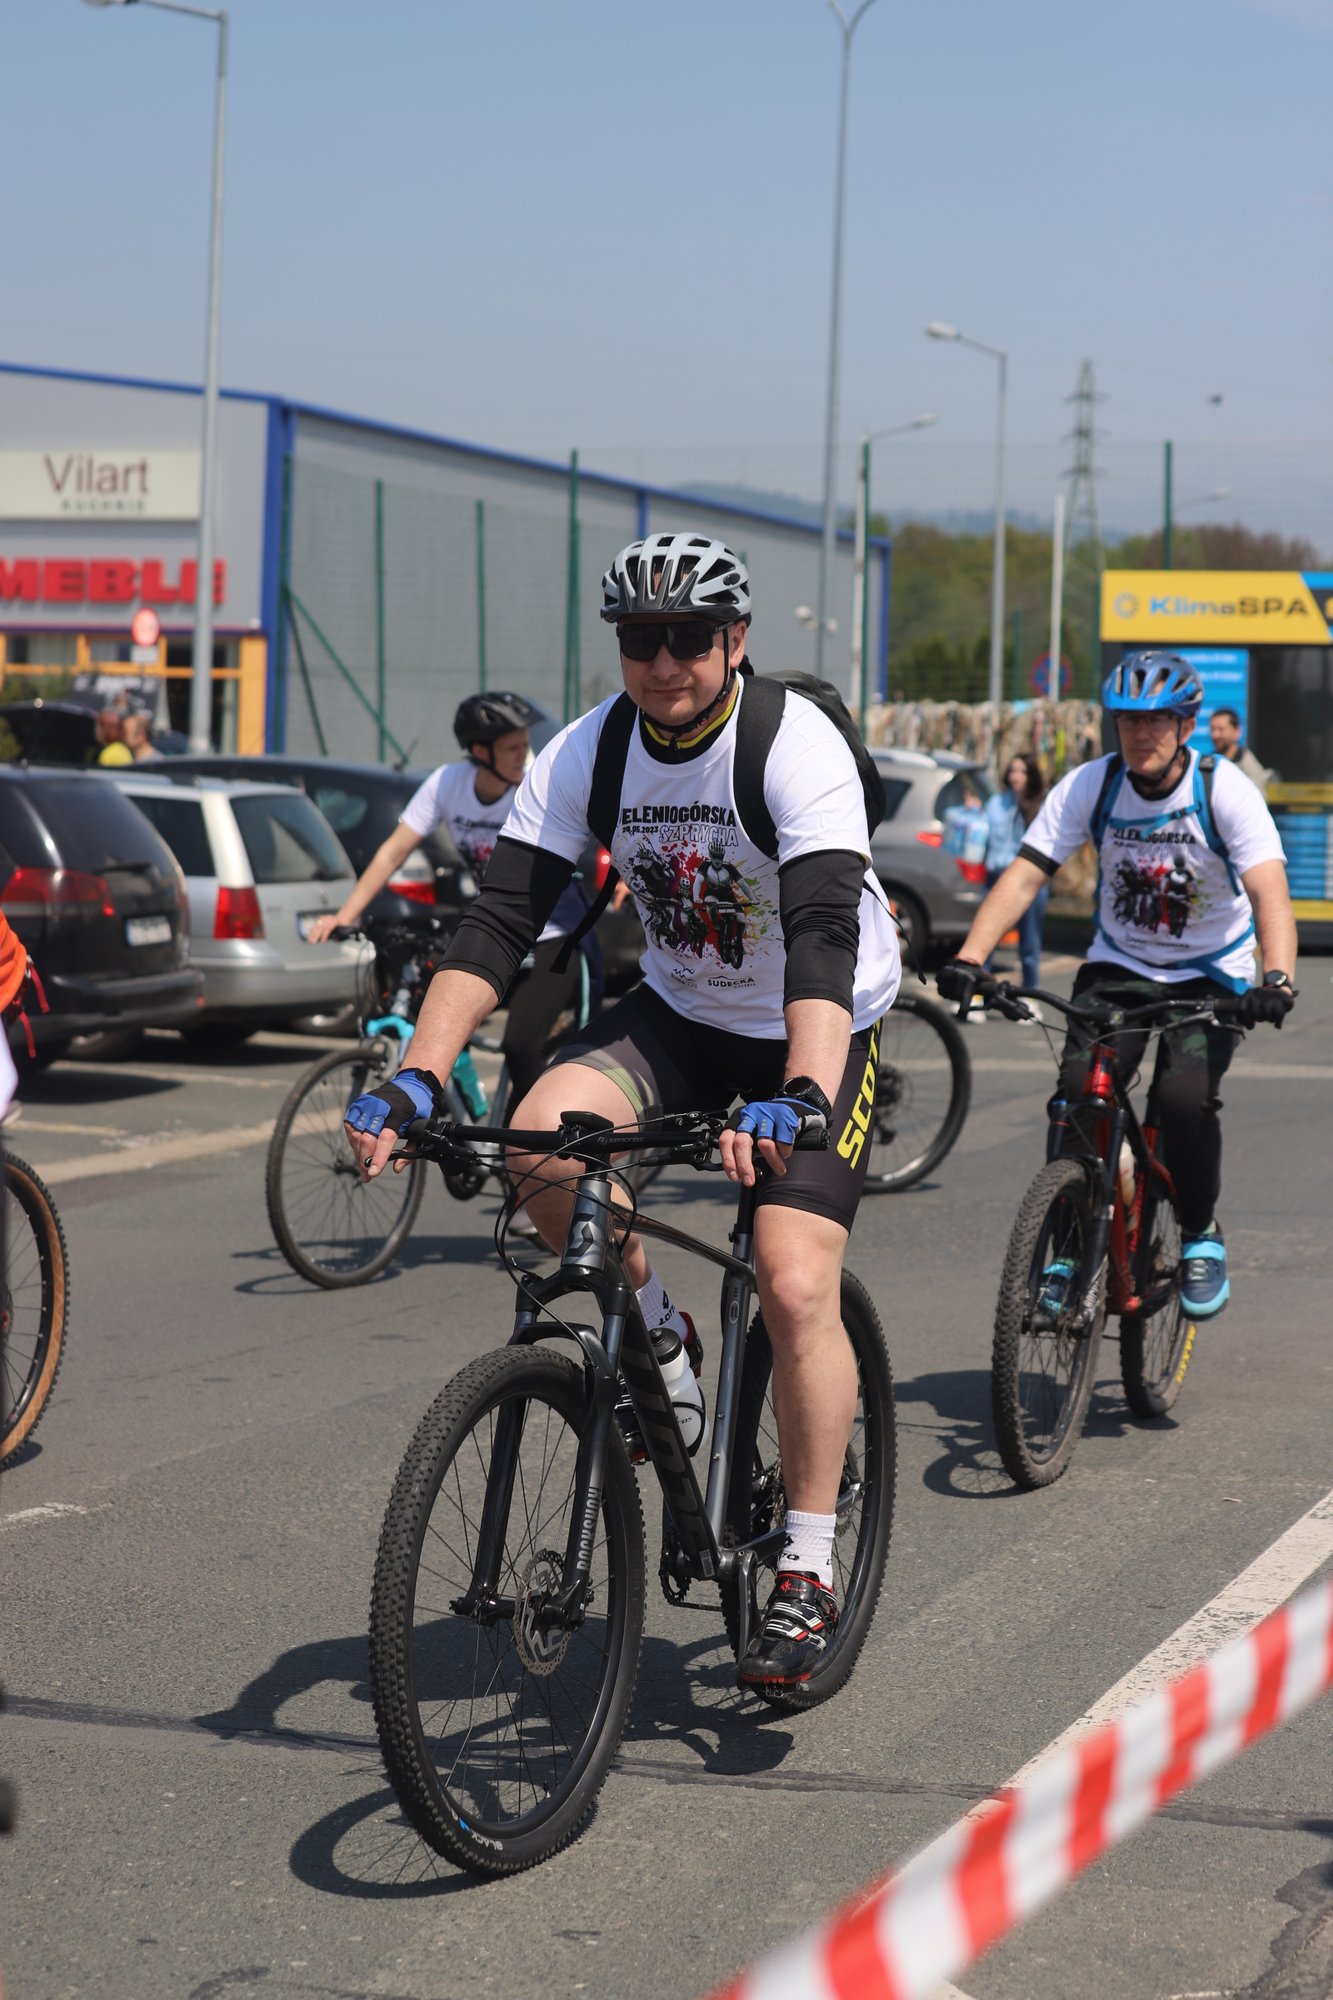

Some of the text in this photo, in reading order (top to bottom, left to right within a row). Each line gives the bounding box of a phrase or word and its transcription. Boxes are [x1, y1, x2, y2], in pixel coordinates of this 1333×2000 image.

[44, 453, 149, 493] Vilart
[1150, 594, 1310, 618] KlimaSPA
[622, 801, 737, 828] ELENIOGÓRSKA
[658, 824, 739, 847] SZPRYCHA
[707, 976, 756, 988] SUDECKA
